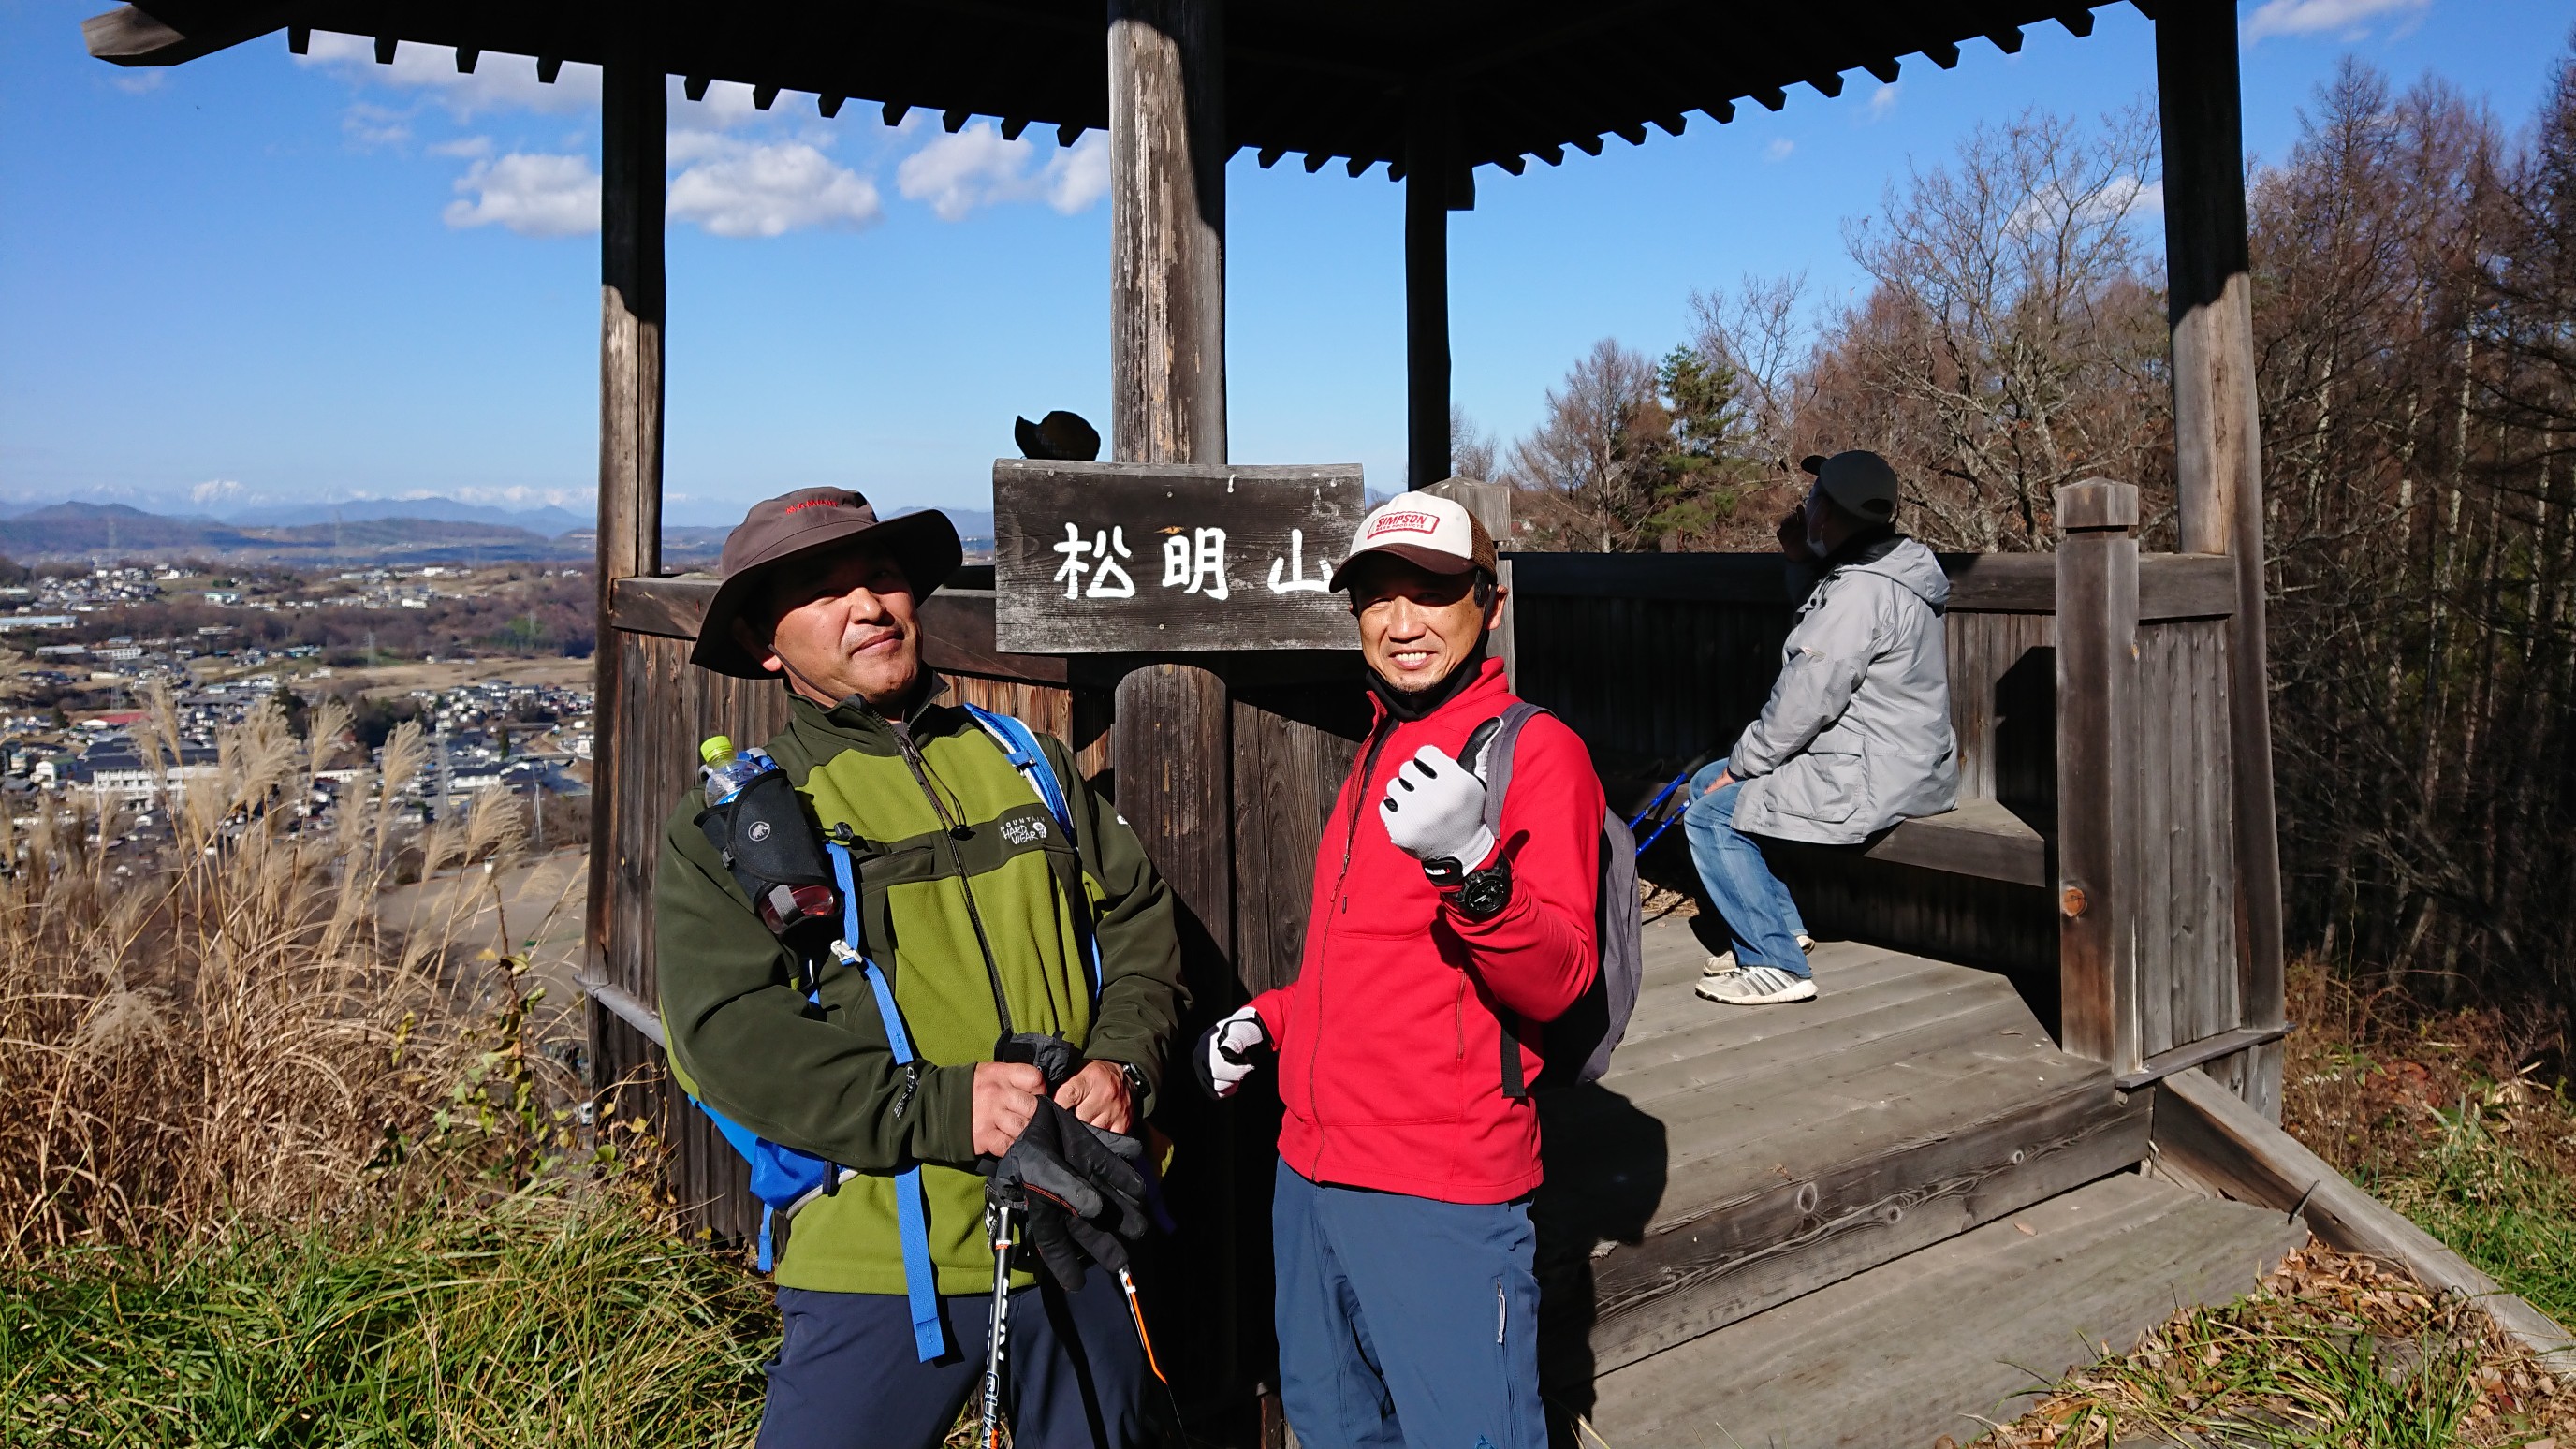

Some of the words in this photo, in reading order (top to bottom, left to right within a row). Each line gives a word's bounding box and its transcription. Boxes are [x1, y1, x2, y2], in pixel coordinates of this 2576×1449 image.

[1376, 514, 1427, 527] SIMPSON
[1053, 522, 1333, 600] 松明山
[1000, 816, 1045, 831] MOUNTAIN
[1003, 825, 1028, 841] HARD
[1011, 830, 1039, 845] WEAR
